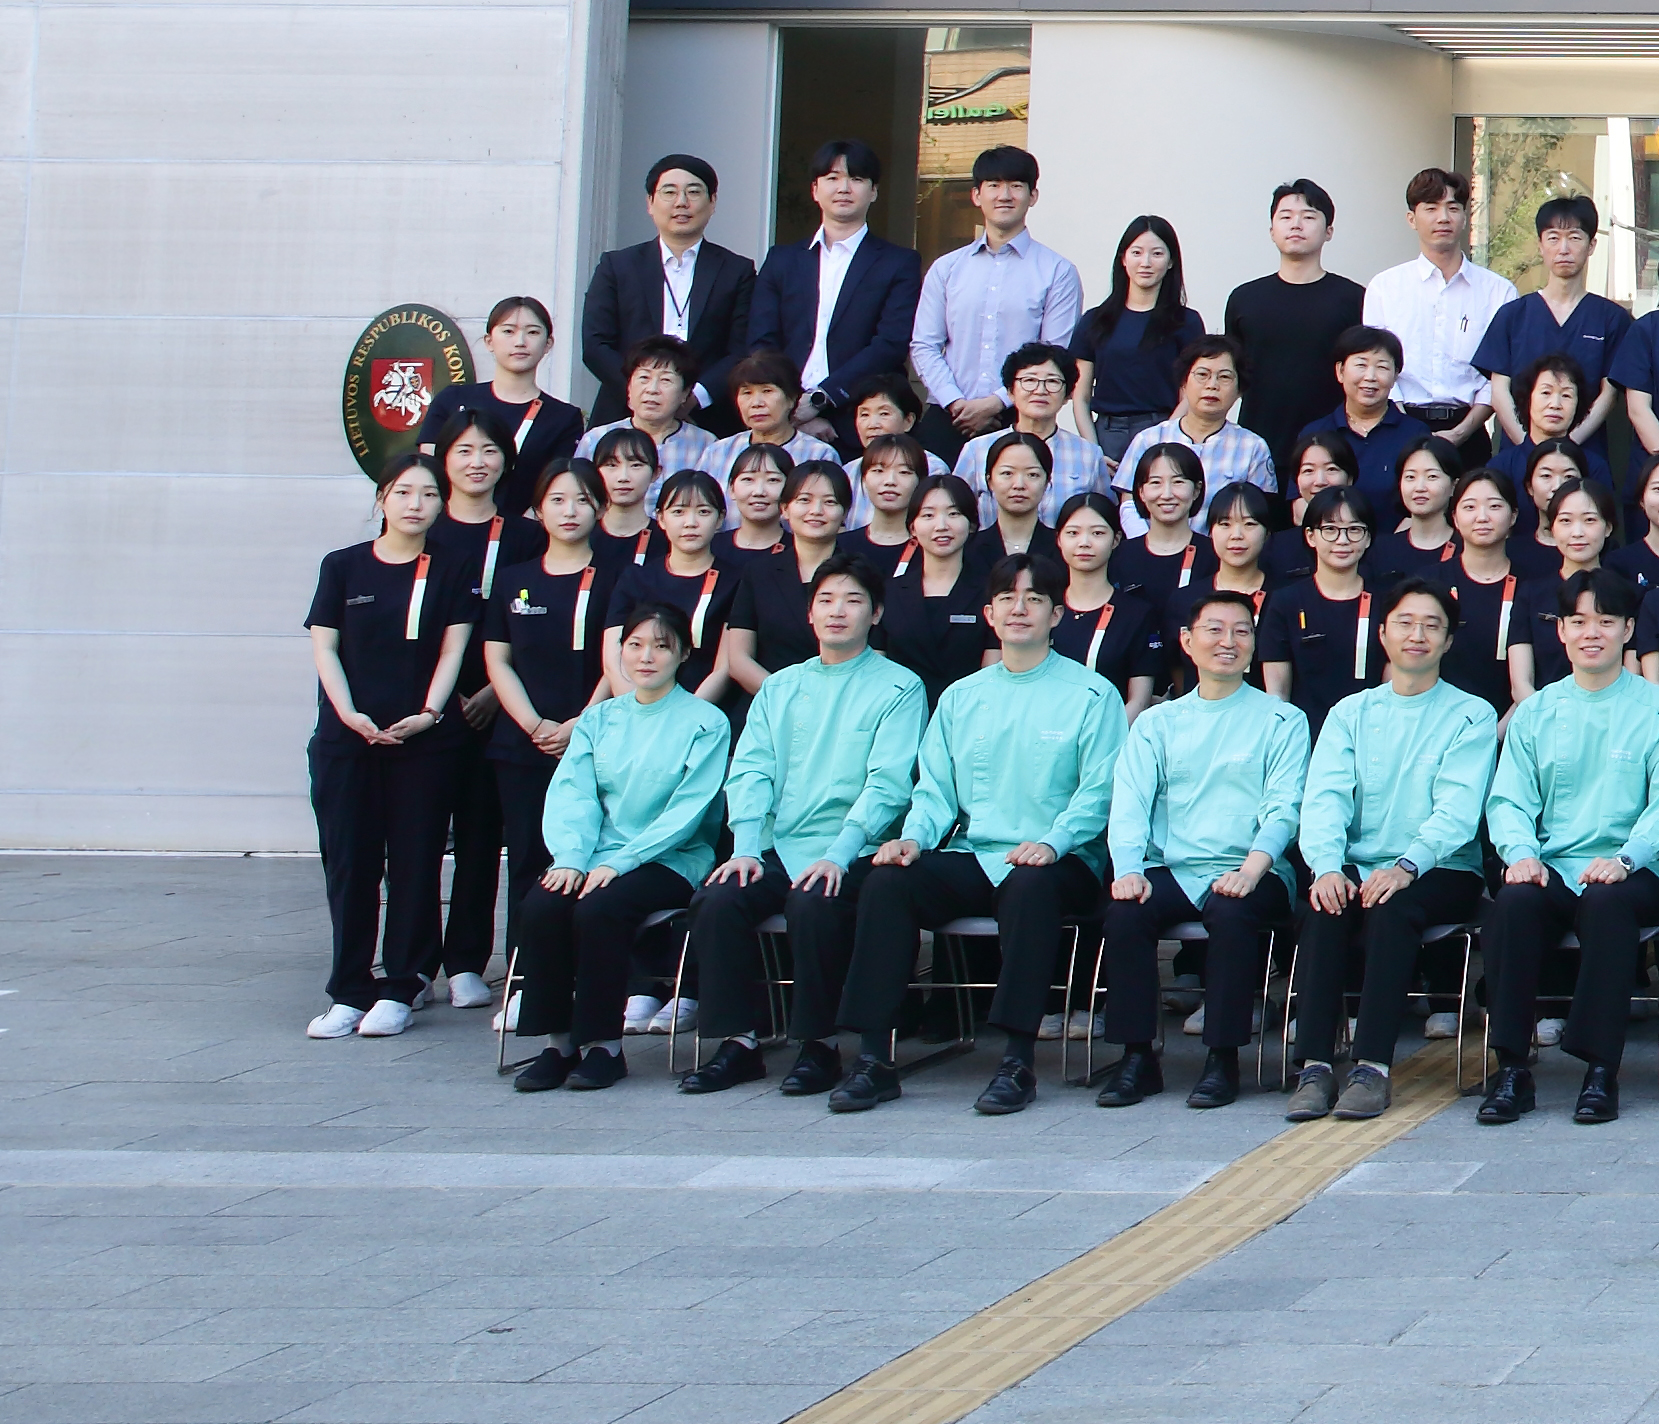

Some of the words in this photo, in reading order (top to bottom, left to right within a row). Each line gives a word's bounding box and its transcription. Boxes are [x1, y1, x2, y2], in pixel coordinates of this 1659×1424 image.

[353, 310, 451, 368] RESPUBLIKOS
[442, 343, 467, 386] KON
[346, 373, 370, 458] LIETUVOS
